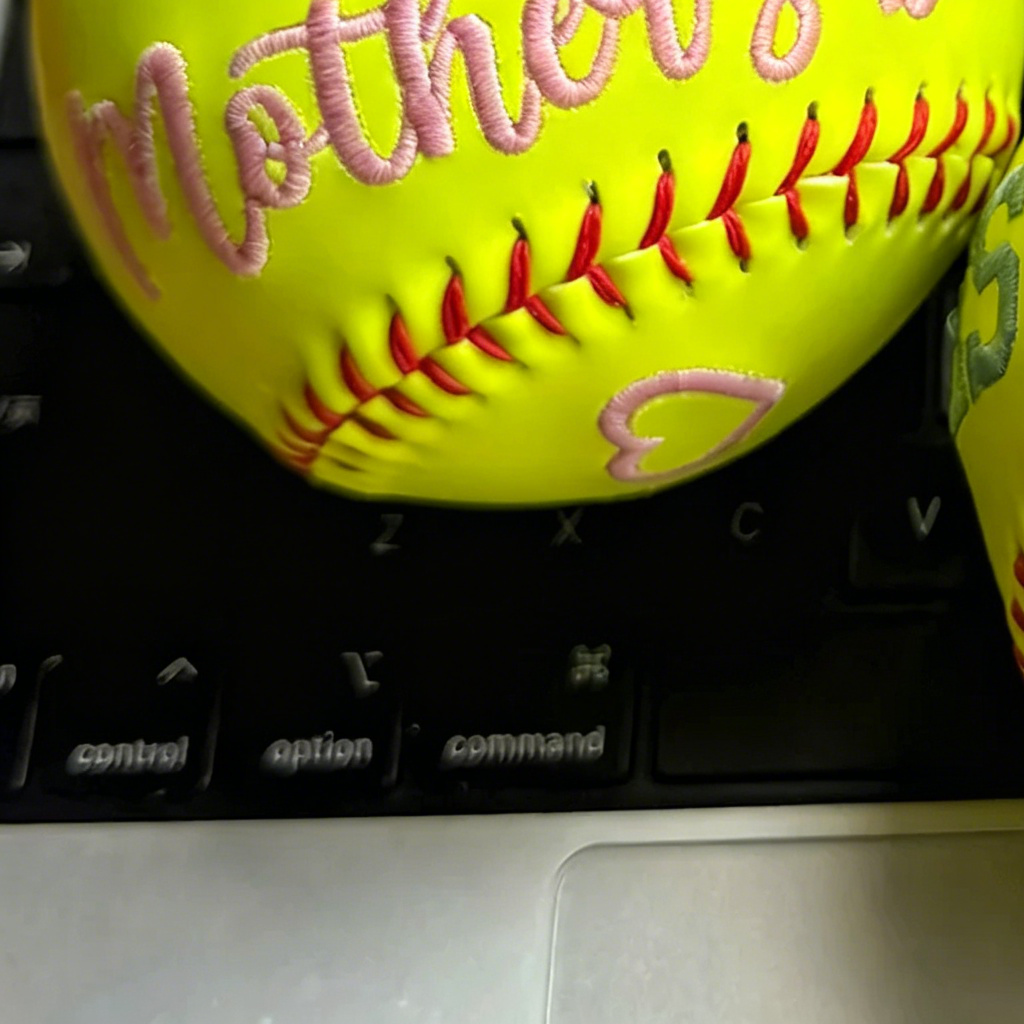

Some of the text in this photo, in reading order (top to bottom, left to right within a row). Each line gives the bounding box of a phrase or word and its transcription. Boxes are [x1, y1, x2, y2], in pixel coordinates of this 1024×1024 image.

[730, 502, 764, 544] C
[906, 495, 942, 542] V
[66, 735, 190, 777] control
[259, 731, 373, 777] option
[440, 725, 606, 770] command
